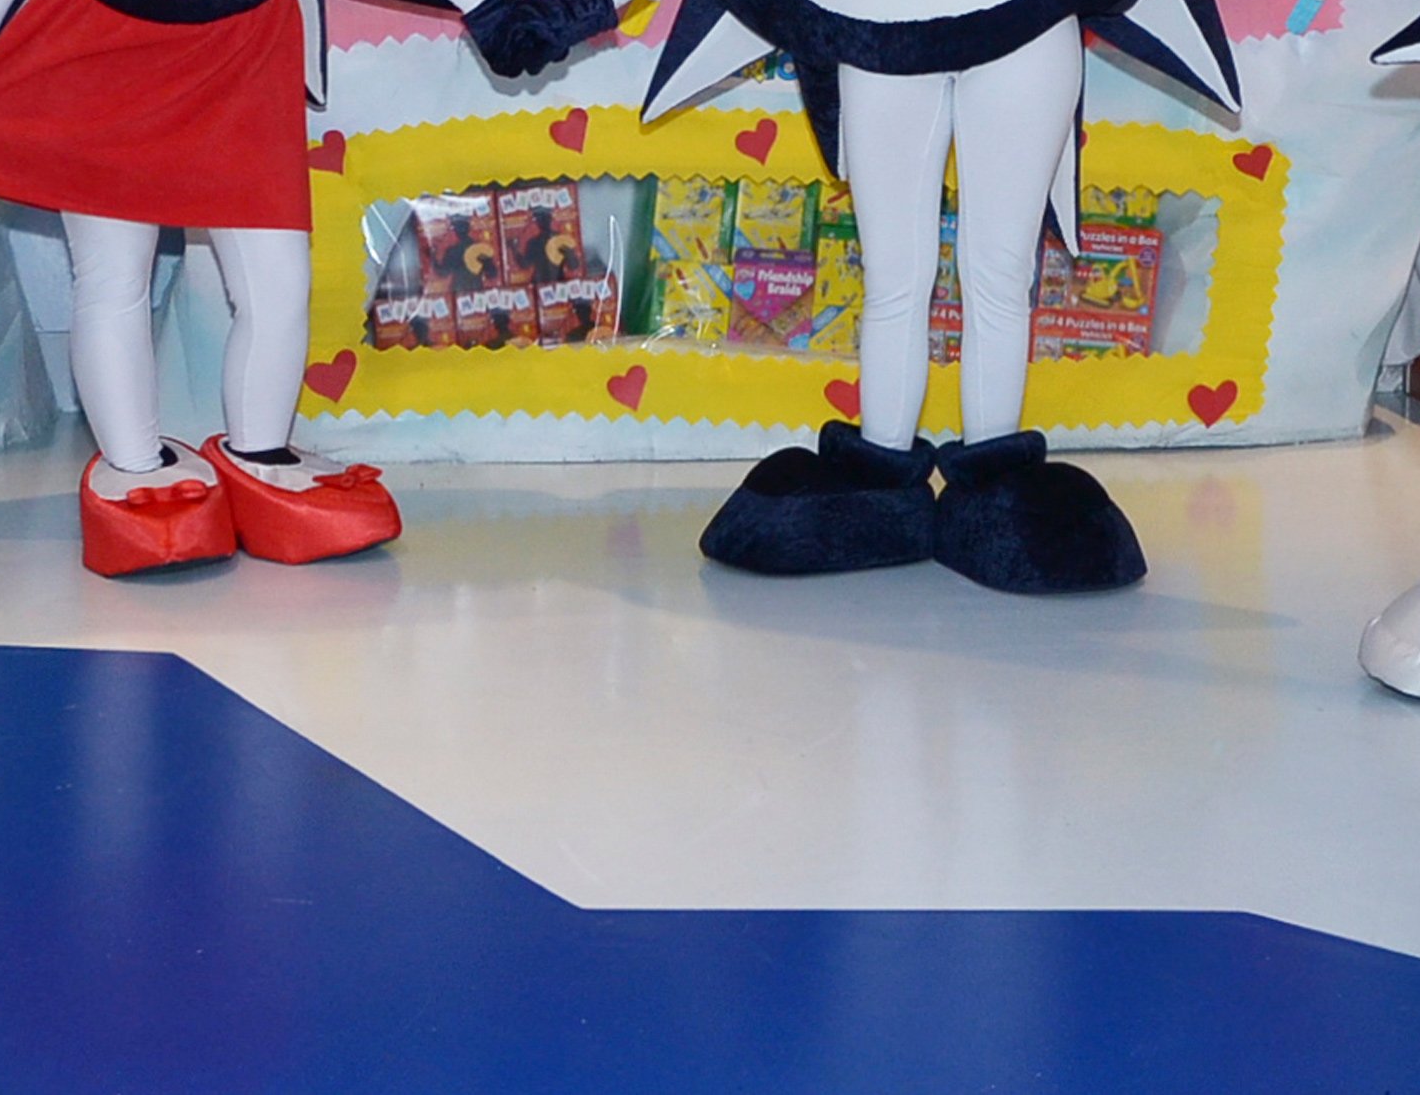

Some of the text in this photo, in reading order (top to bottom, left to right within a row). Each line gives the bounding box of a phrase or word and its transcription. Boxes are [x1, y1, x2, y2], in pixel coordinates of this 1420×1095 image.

[1138, 236, 1157, 245] Box
[758, 269, 813, 287] Friendship
[767, 282, 802, 296] Braids
[1066, 316, 1105, 329] Puzzles
[1128, 322, 1147, 333] Box
